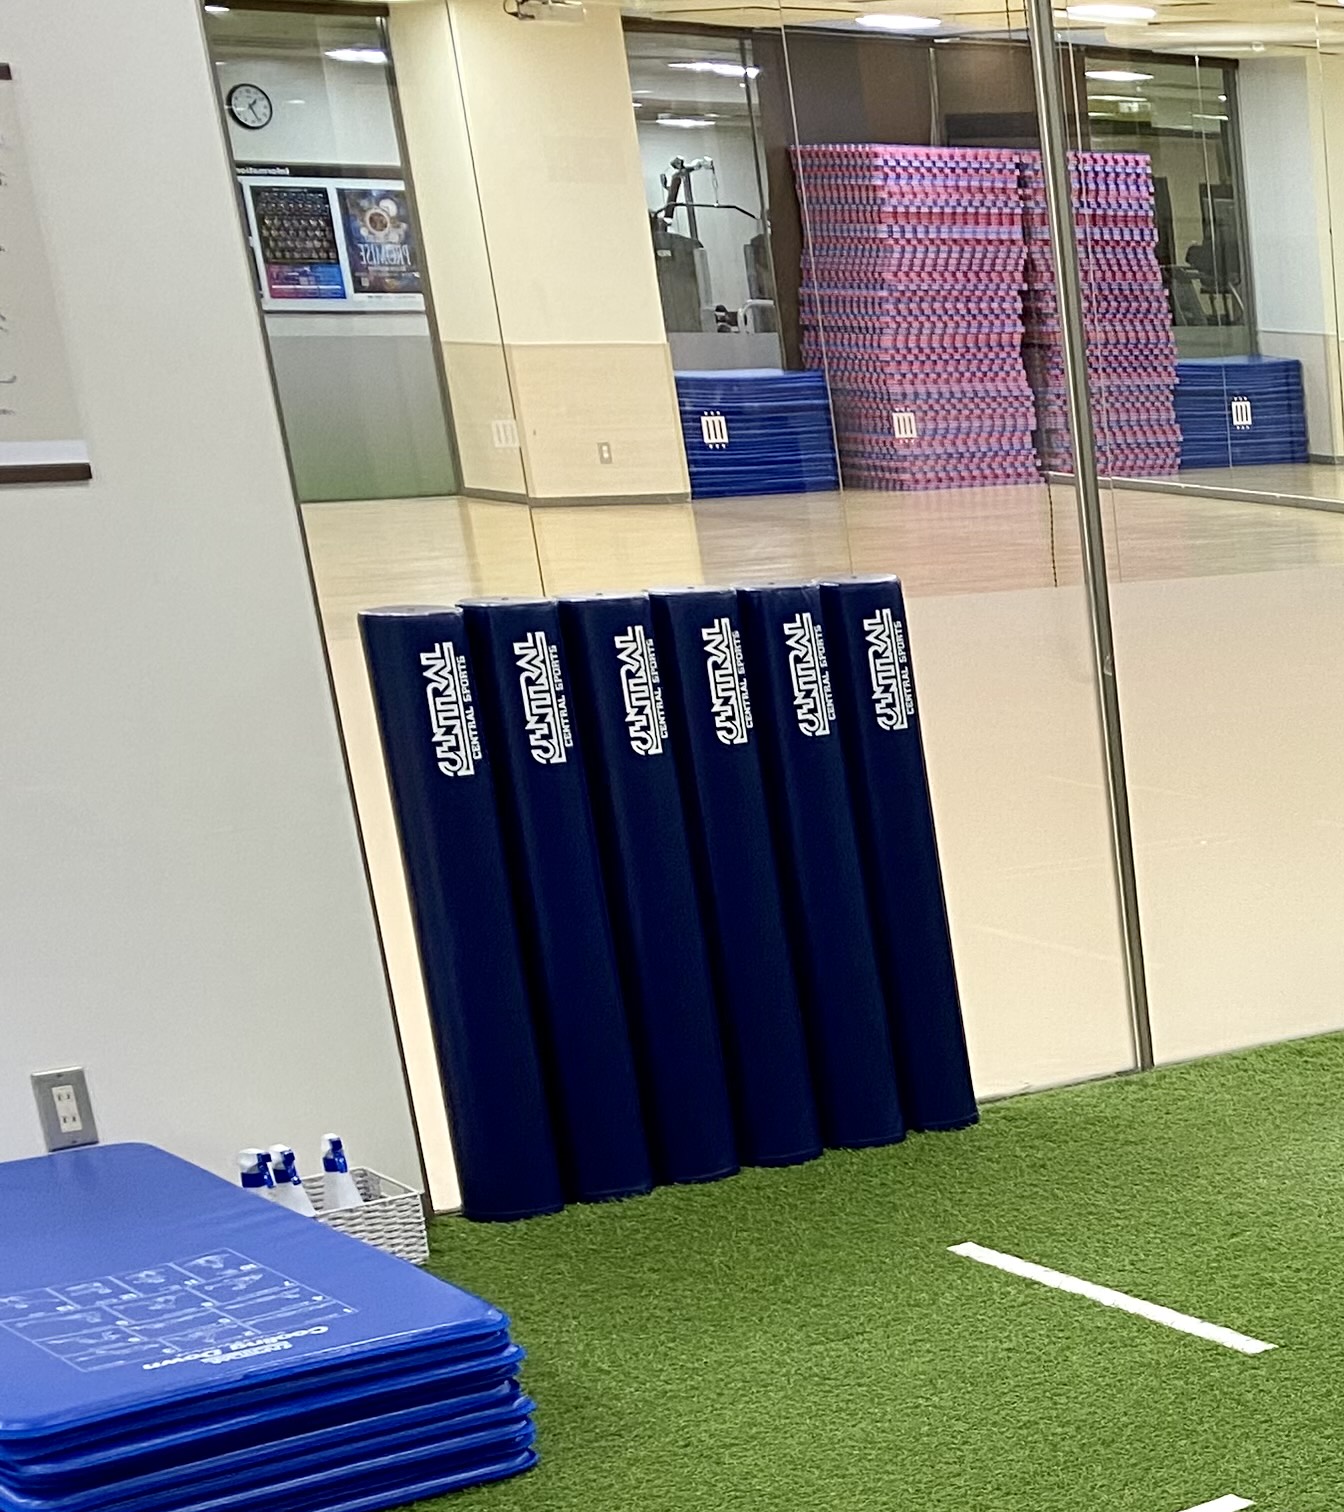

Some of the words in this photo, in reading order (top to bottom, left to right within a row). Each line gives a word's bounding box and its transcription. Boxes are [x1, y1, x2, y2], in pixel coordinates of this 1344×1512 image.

[646, 638, 661, 683] SPORTS
[732, 630, 746, 675] SPORTS
[814, 624, 828, 668] SPORTS
[893, 620, 908, 663] SPORTS
[456, 655, 472, 702] SPORTS
[548, 645, 564, 691] SPORTS
[900, 666, 914, 715] CENTRAL
[655, 687, 669, 739] CENTRAL
[739, 678, 754, 729] CENTRAL
[822, 671, 836, 721] CENTRAL
[465, 706, 482, 760] CENTRAL
[556, 694, 574, 748] CENTRAL
[142, 1349, 222, 1370] Down
[230, 1326, 329, 1351] Cooling
